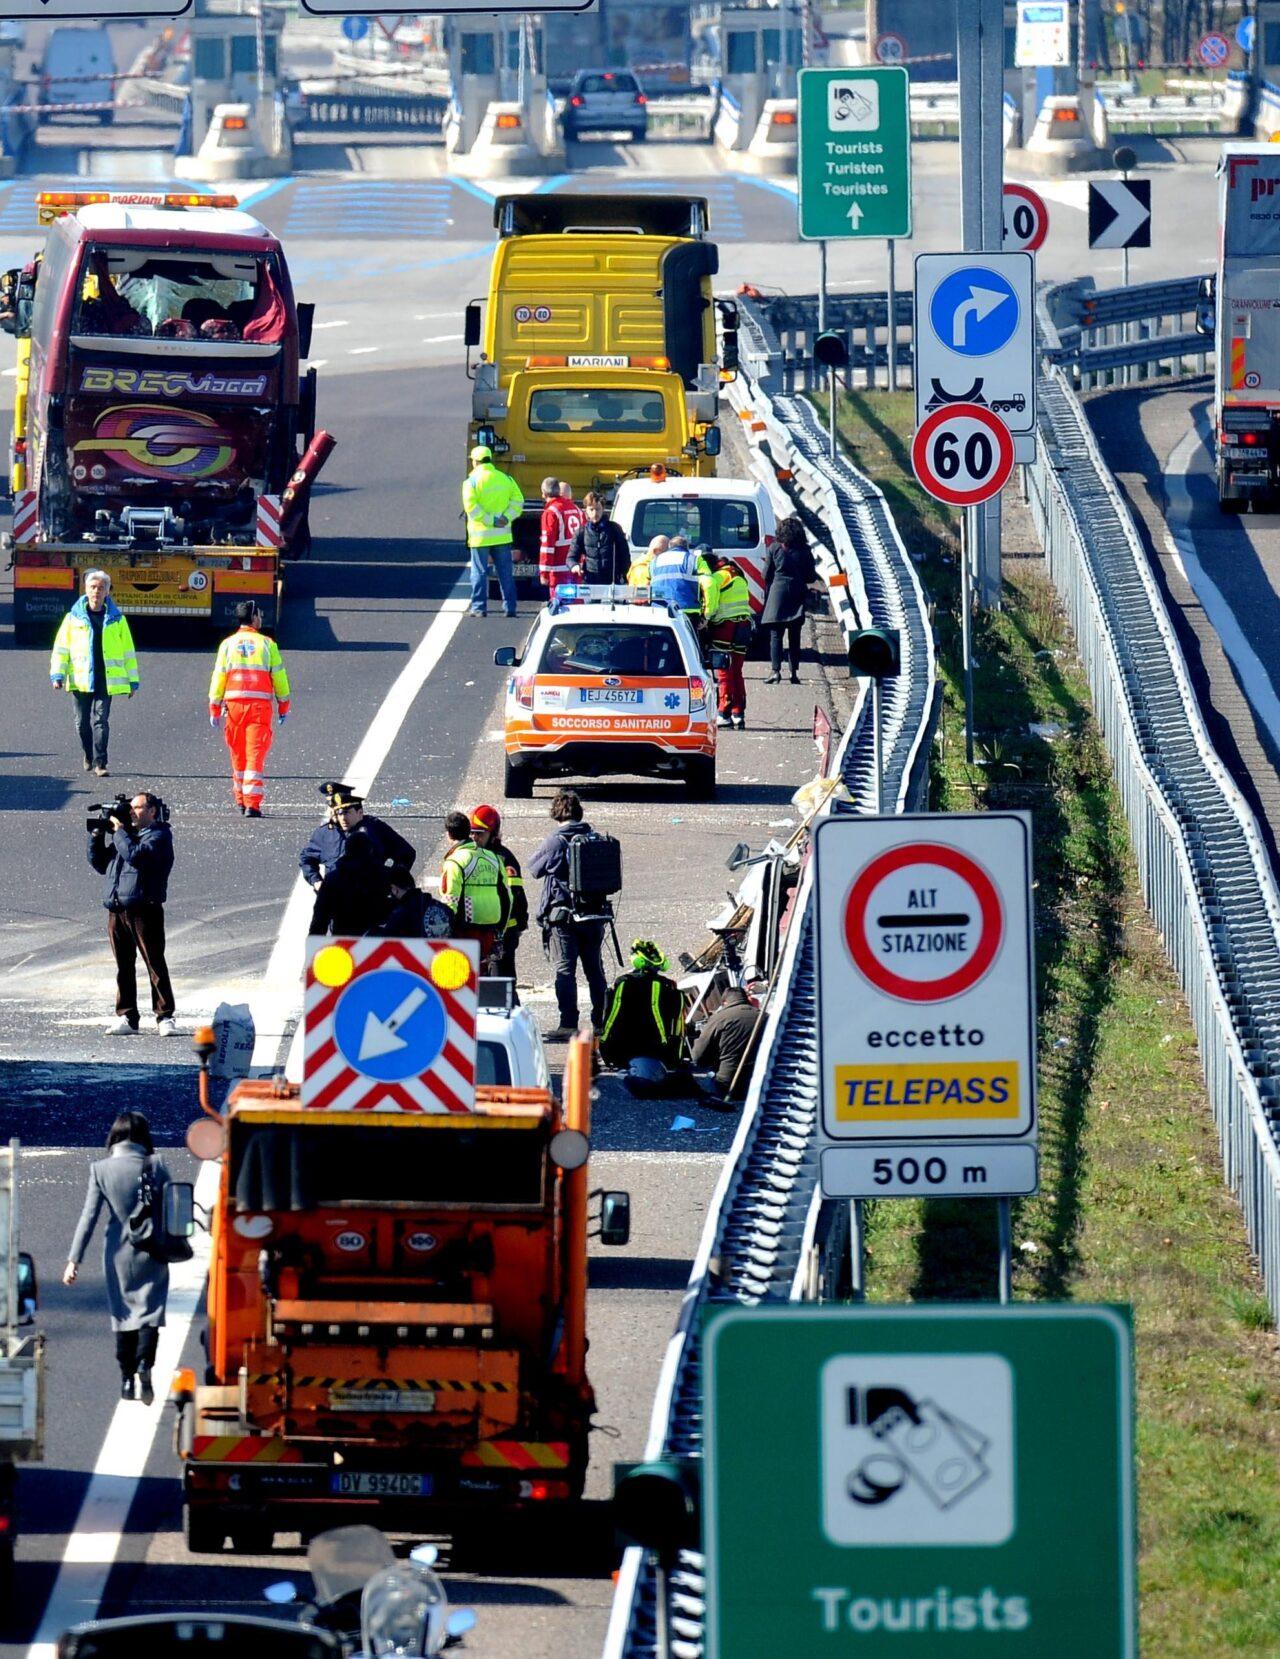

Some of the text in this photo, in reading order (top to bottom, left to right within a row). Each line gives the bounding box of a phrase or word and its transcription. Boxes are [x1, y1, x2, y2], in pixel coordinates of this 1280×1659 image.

[825, 142, 884, 155] Tourists
[825, 161, 884, 175] Turisten
[822, 182, 888, 196] Touristes
[519, 310, 528, 320] 70
[571, 358, 624, 367] MARIANI
[1248, 374, 1258, 386] 70
[933, 431, 993, 480] 60
[193, 576, 204, 586] 80
[588, 690, 636, 703] EJ 456YZ
[552, 717, 672, 730] SOCCORSO SANITARIO
[907, 889, 937, 908] ALT
[882, 933, 967, 953] STAZIONE
[867, 1024, 984, 1048] eccetto
[844, 1077, 1009, 1106] TELEPASS
[873, 1157, 987, 1184] 500 m
[340, 1236, 361, 1246] 80
[341, 1475, 361, 1491] DV
[812, 1586, 1030, 1632] Tourists
